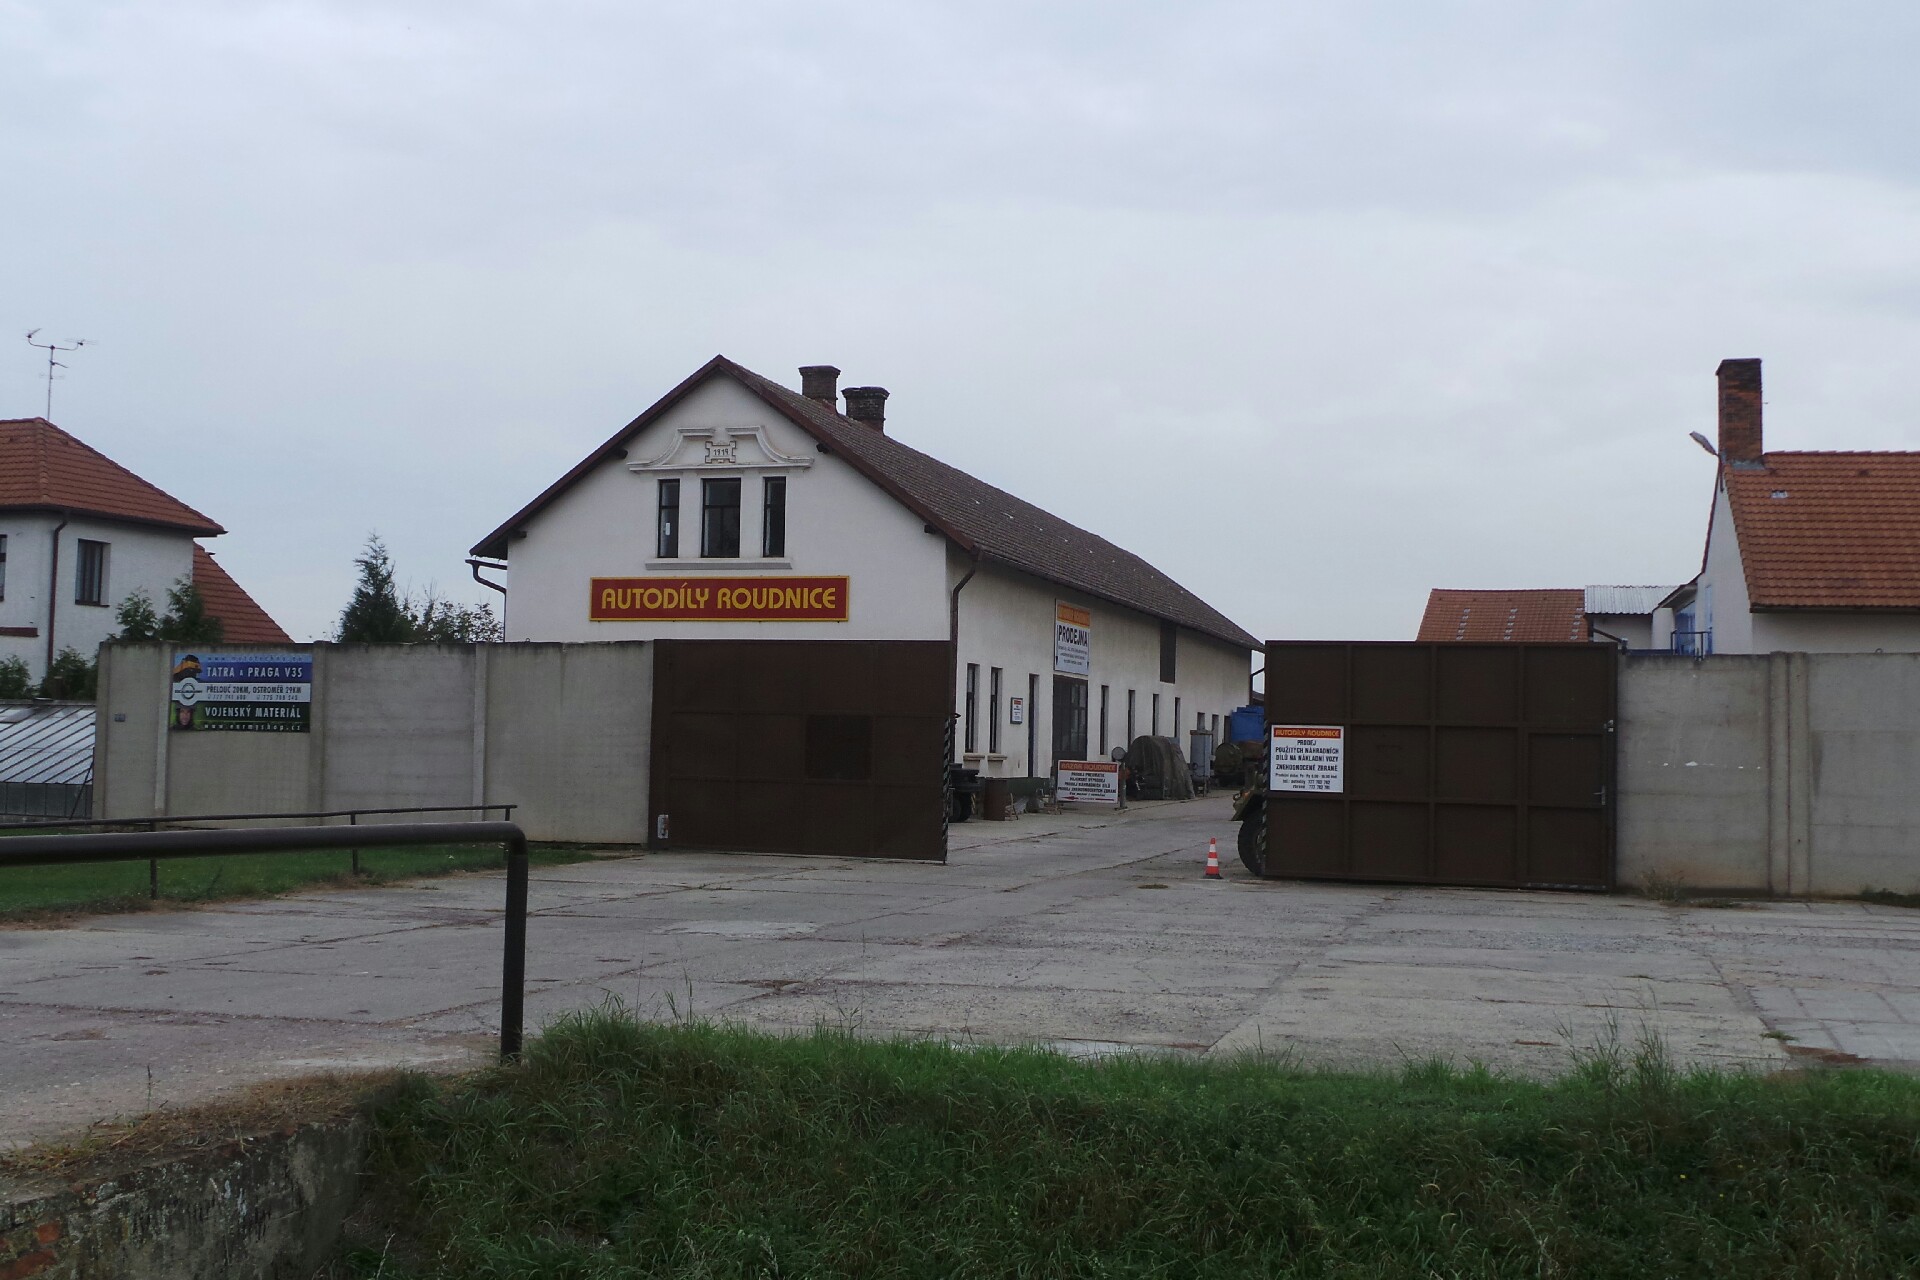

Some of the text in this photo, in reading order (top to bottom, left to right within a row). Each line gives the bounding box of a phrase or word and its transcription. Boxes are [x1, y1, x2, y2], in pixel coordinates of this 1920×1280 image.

[601, 582, 836, 610] AUTODÍLY ROUDNICE
[1058, 625, 1088, 647] PRODEJNA
[206, 667, 235, 677] TATRA
[247, 667, 280, 677] PRAGA
[285, 667, 303, 678] V3S
[205, 705, 301, 718] VOJENSKÝ MATERIÁL
[1307, 729, 1339, 737] ROUDNICE
